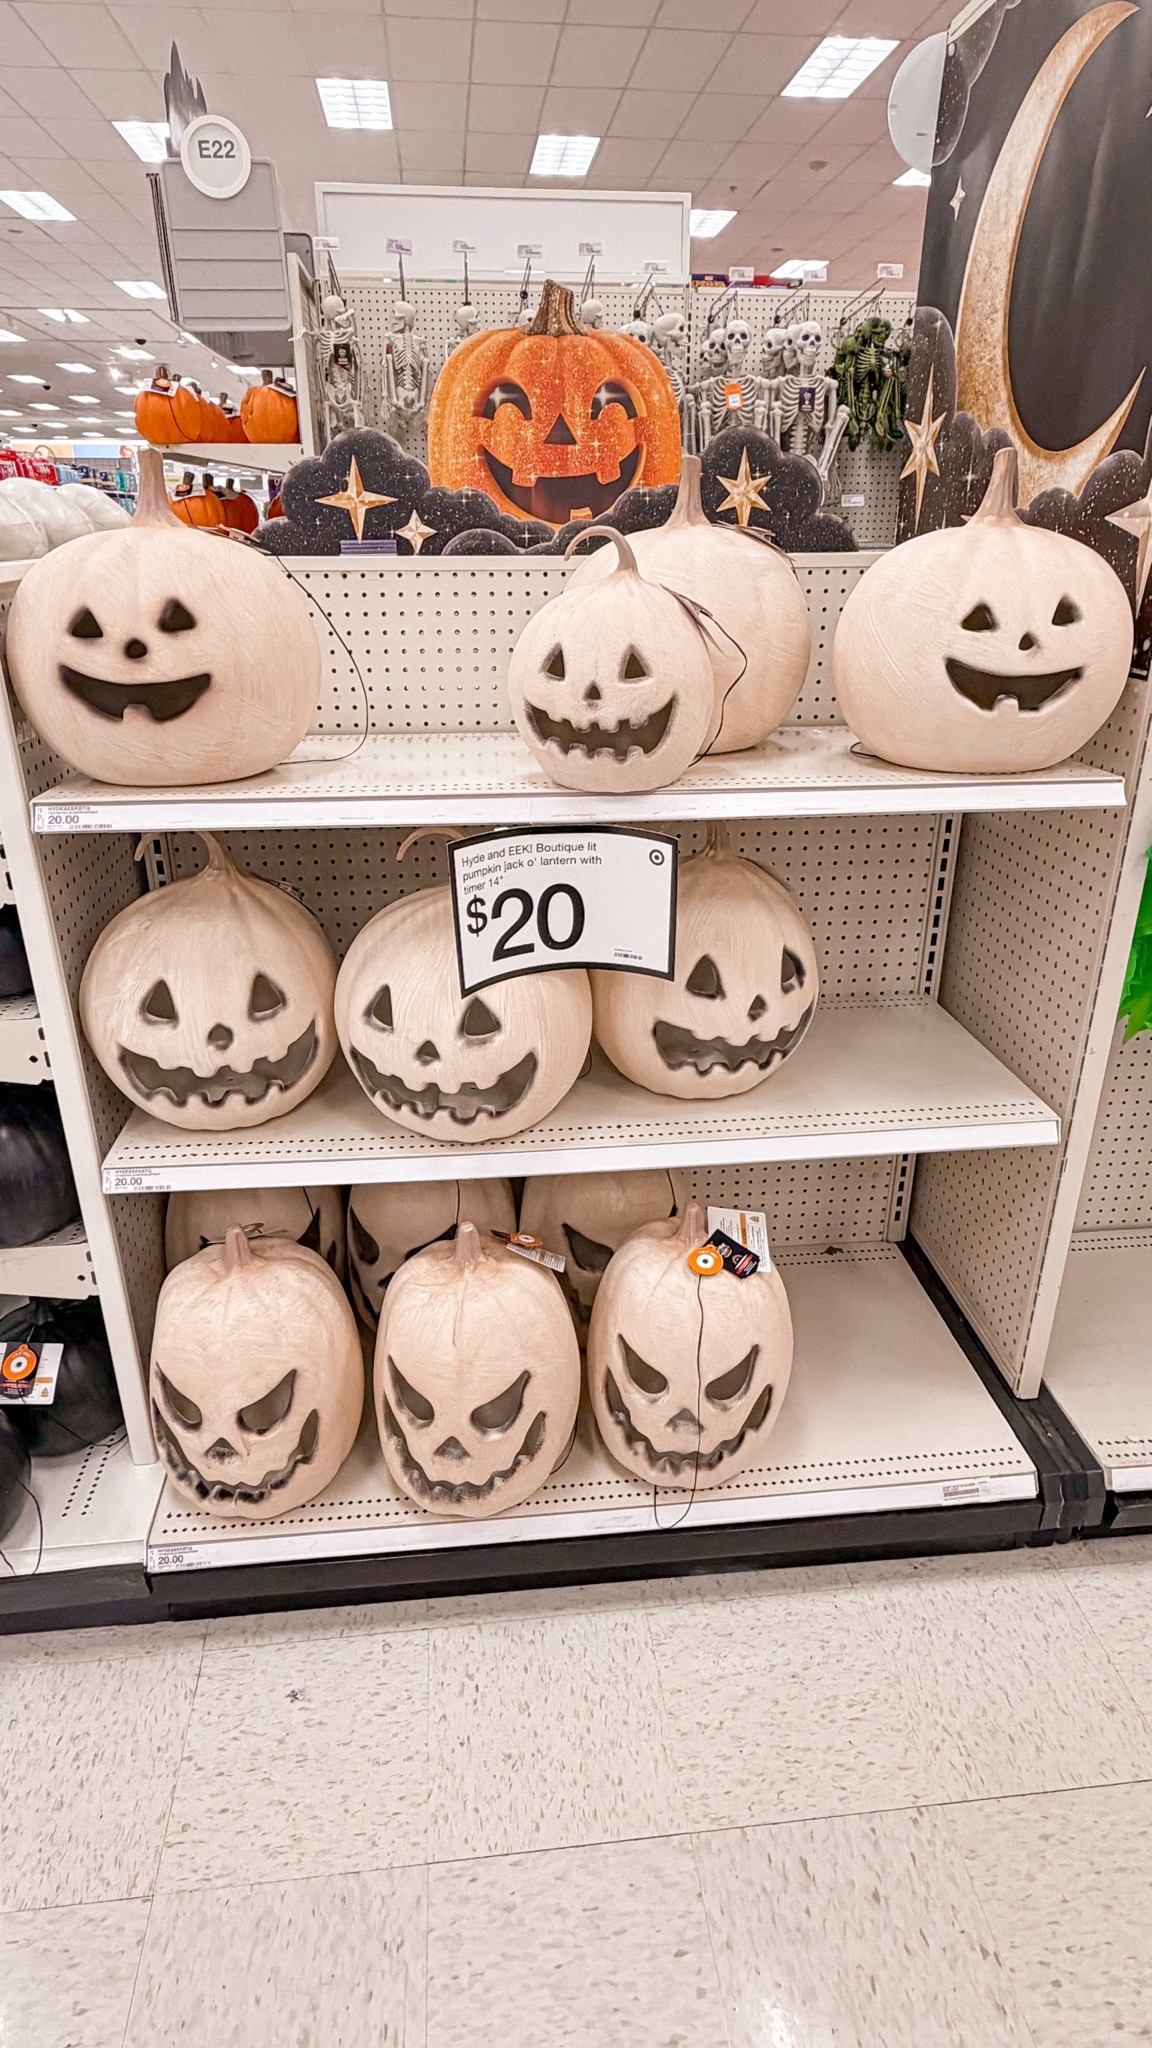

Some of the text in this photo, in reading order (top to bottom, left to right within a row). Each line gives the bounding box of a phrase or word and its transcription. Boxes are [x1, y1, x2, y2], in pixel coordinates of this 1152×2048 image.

[198, 140, 236, 158] E22
[48, 815, 79, 824] 20.00
[461, 842, 597, 868] Hyde and EEK! Boutique lit
[462, 855, 602, 883] pumpkin jack o' lantern with
[463, 881, 486, 895] timer
[466, 883, 585, 962] $20
[115, 1177, 142, 1186] 20.00
[158, 1555, 184, 1564] 20.00
